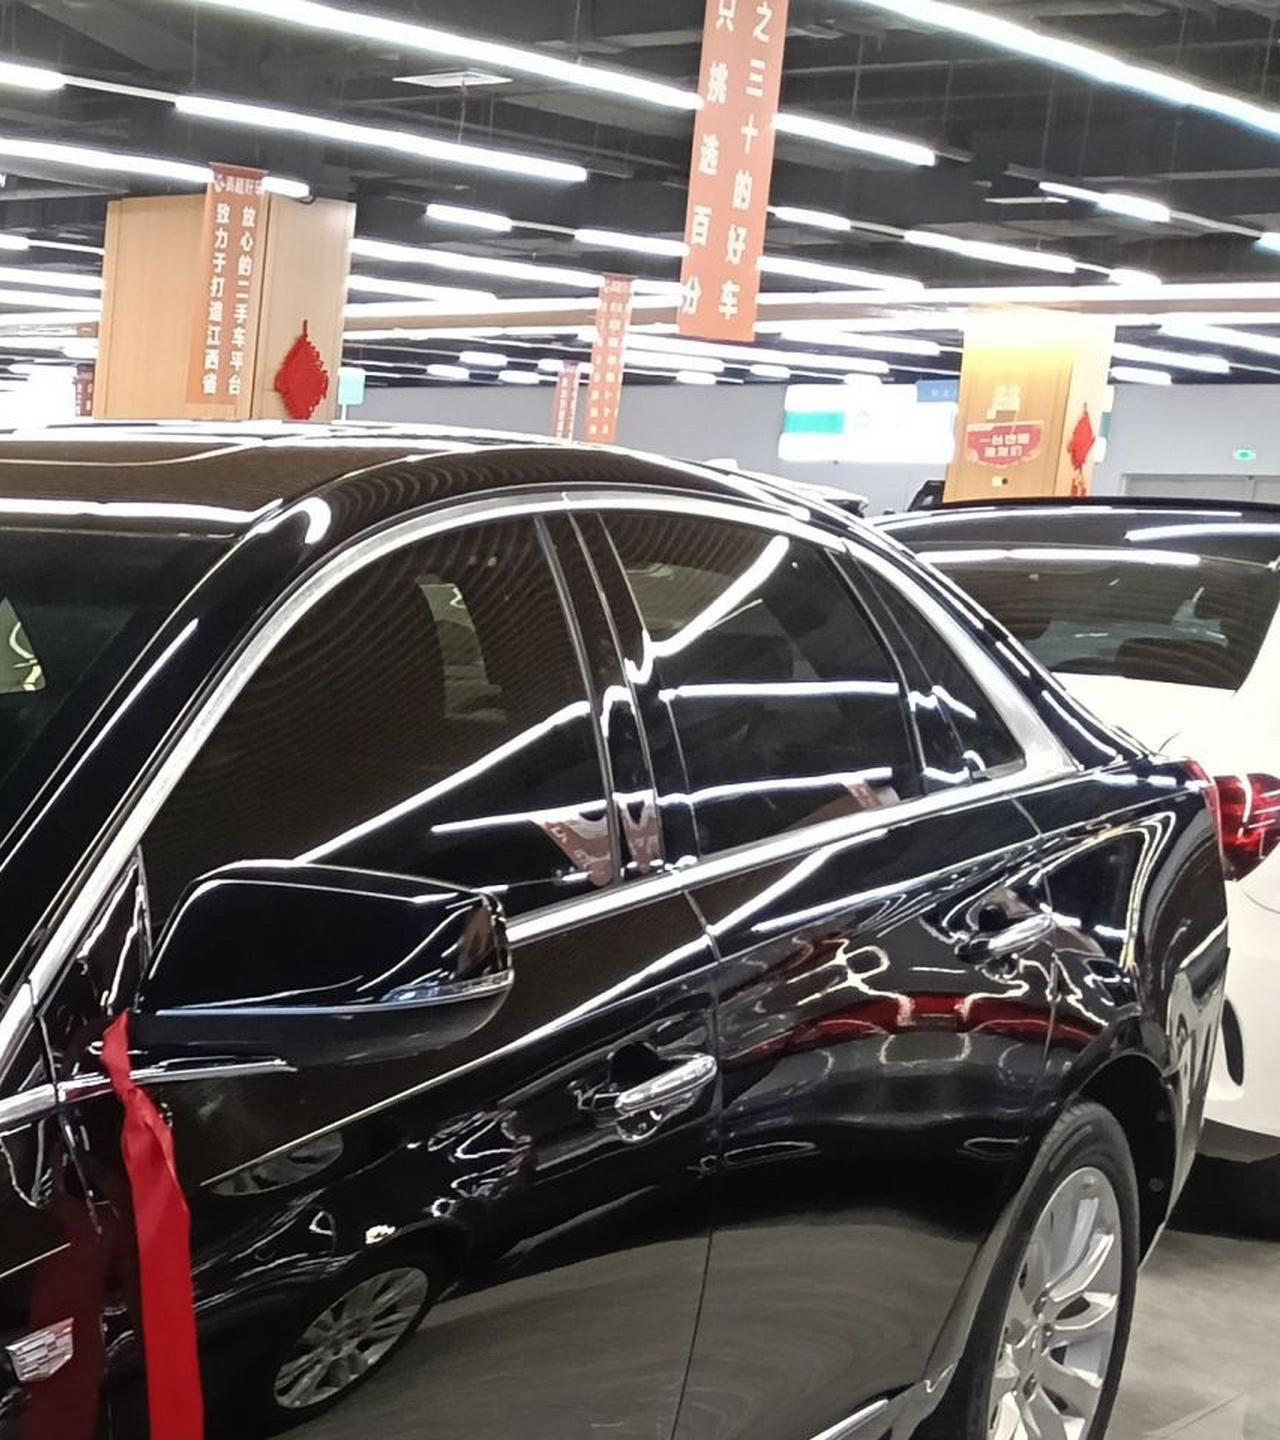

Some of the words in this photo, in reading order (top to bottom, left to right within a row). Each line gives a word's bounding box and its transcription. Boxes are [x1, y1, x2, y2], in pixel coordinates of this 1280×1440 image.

[681, 0, 736, 314] 只挑选百分
[719, 1, 773, 320] 之三十的好车
[202, 203, 231, 395] 致力于打造江西省
[228, 207, 256, 396] 放心的二手车平台
